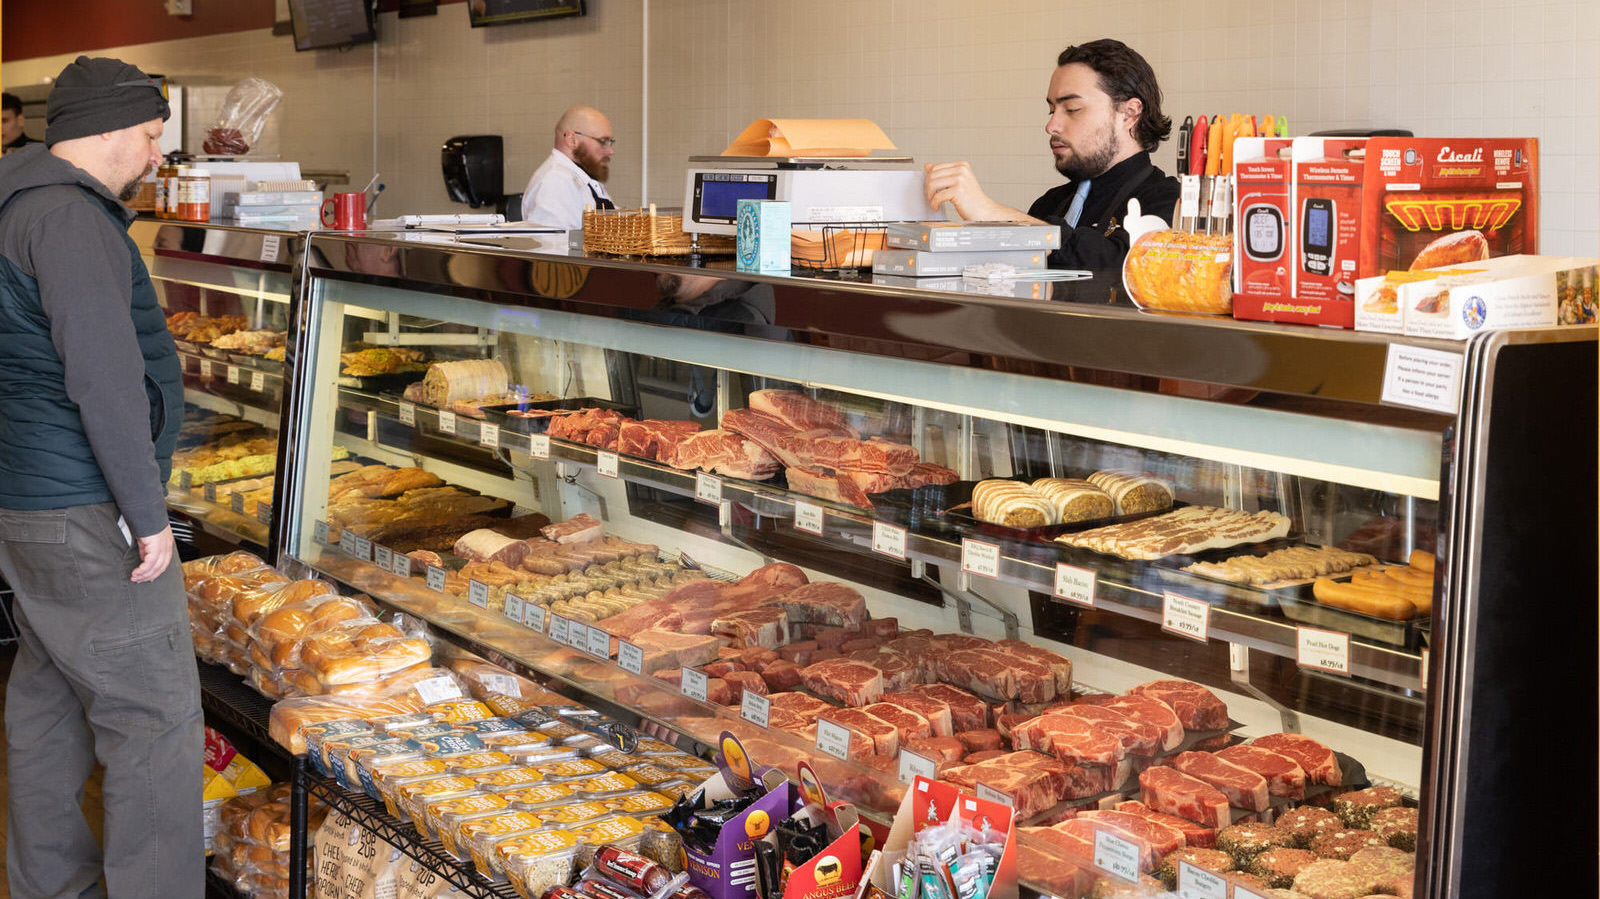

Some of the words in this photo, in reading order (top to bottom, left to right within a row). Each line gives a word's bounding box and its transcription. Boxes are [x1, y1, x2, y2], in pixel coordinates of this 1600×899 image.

[1437, 146, 1484, 162] Escali
[1328, 643, 1340, 651] Dogs
[361, 829, 376, 846] POP
[357, 842, 376, 860] ZUP
[690, 861, 719, 879] VENISON
[803, 887, 834, 899] ANGUS
